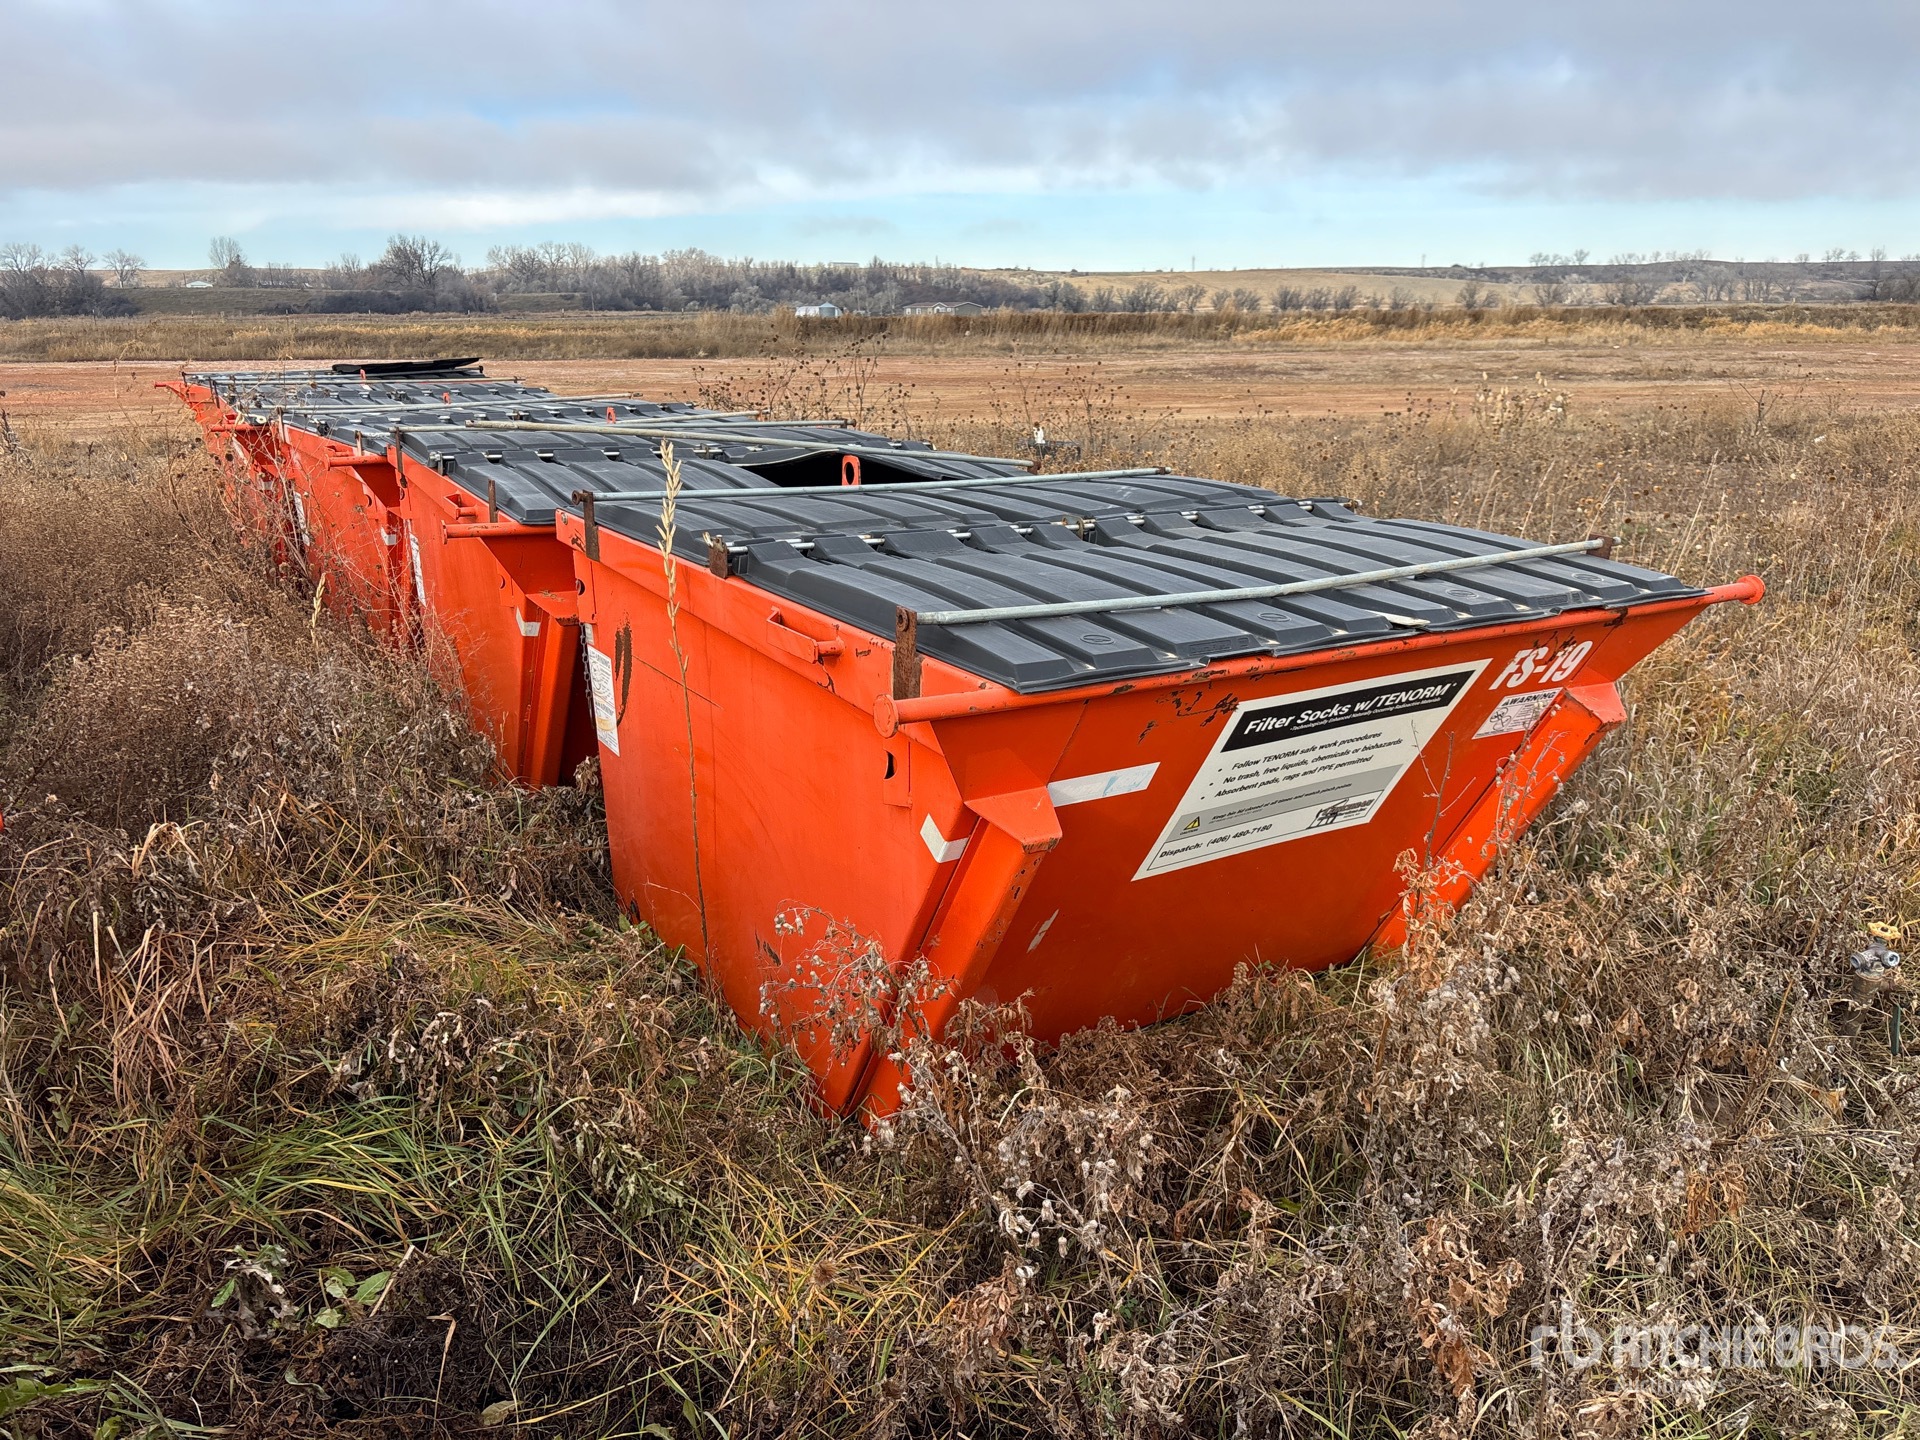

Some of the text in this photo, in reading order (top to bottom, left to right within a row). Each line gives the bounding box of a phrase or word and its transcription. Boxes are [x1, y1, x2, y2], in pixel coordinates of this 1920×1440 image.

[1488, 640, 1593, 690] FS-19
[1243, 716, 1295, 735] Filter
[1296, 703, 1352, 724] Socks
[1232, 732, 1382, 770] Follow TENORM safe work procedures
[1237, 770, 1260, 781] trash,
[1263, 766, 1280, 775] free
[1280, 759, 1309, 771] liquids,
[1311, 749, 1351, 763] chemicals
[1361, 738, 1403, 752] biohazards
[1214, 754, 1374, 797] Absorbent pads, rags and PPE permitted
[1159, 823, 1273, 859] Dispatch: (406) 480-7180
